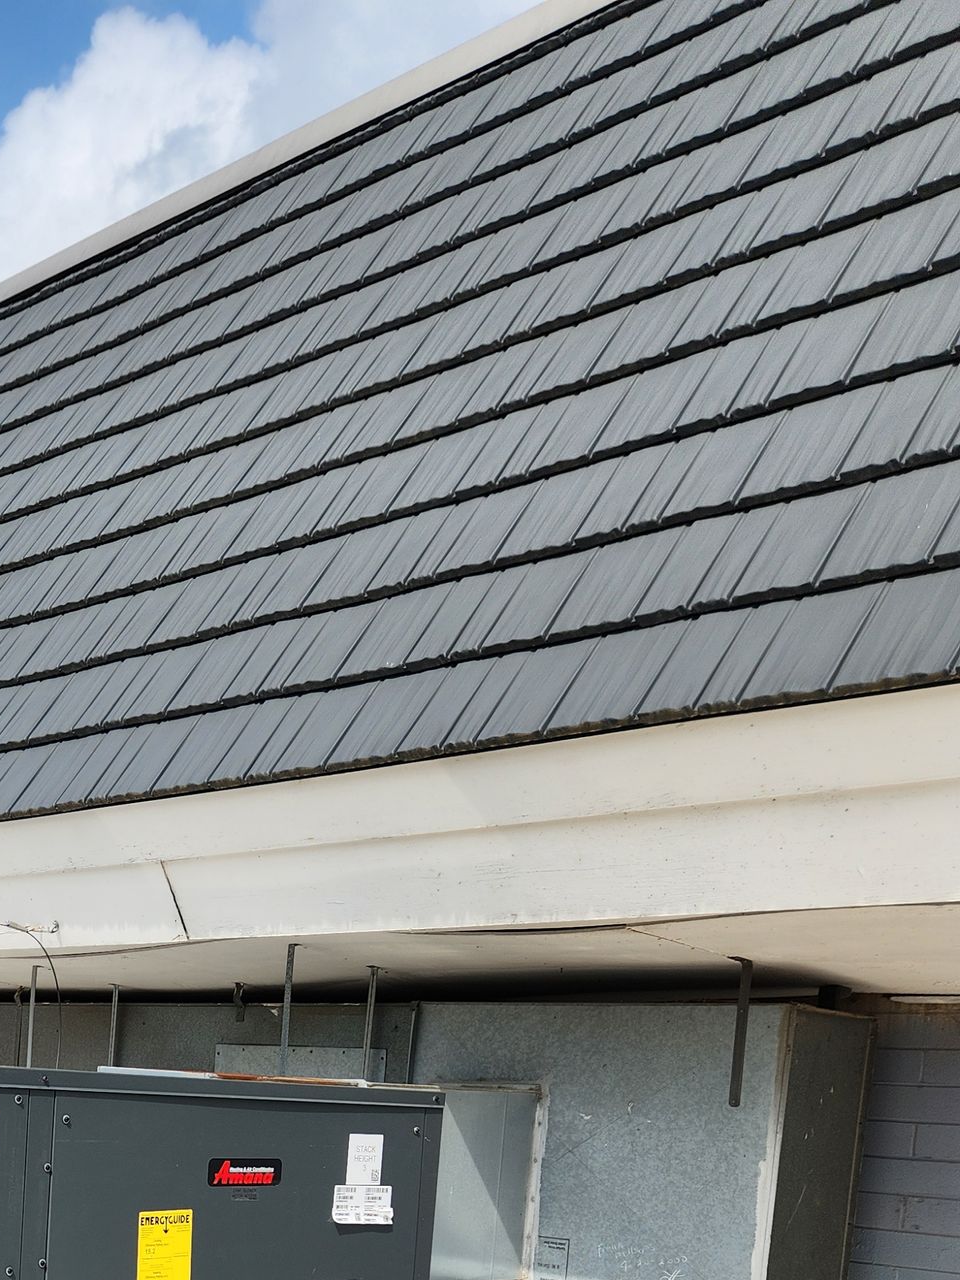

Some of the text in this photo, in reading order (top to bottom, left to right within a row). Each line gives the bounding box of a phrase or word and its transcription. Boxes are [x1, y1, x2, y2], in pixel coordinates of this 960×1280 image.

[356, 1145, 377, 1153] STACK
[354, 1154, 377, 1162] HEIGHT
[213, 1160, 274, 1185] Amana
[140, 1214, 190, 1226] ENERGYGUIDE
